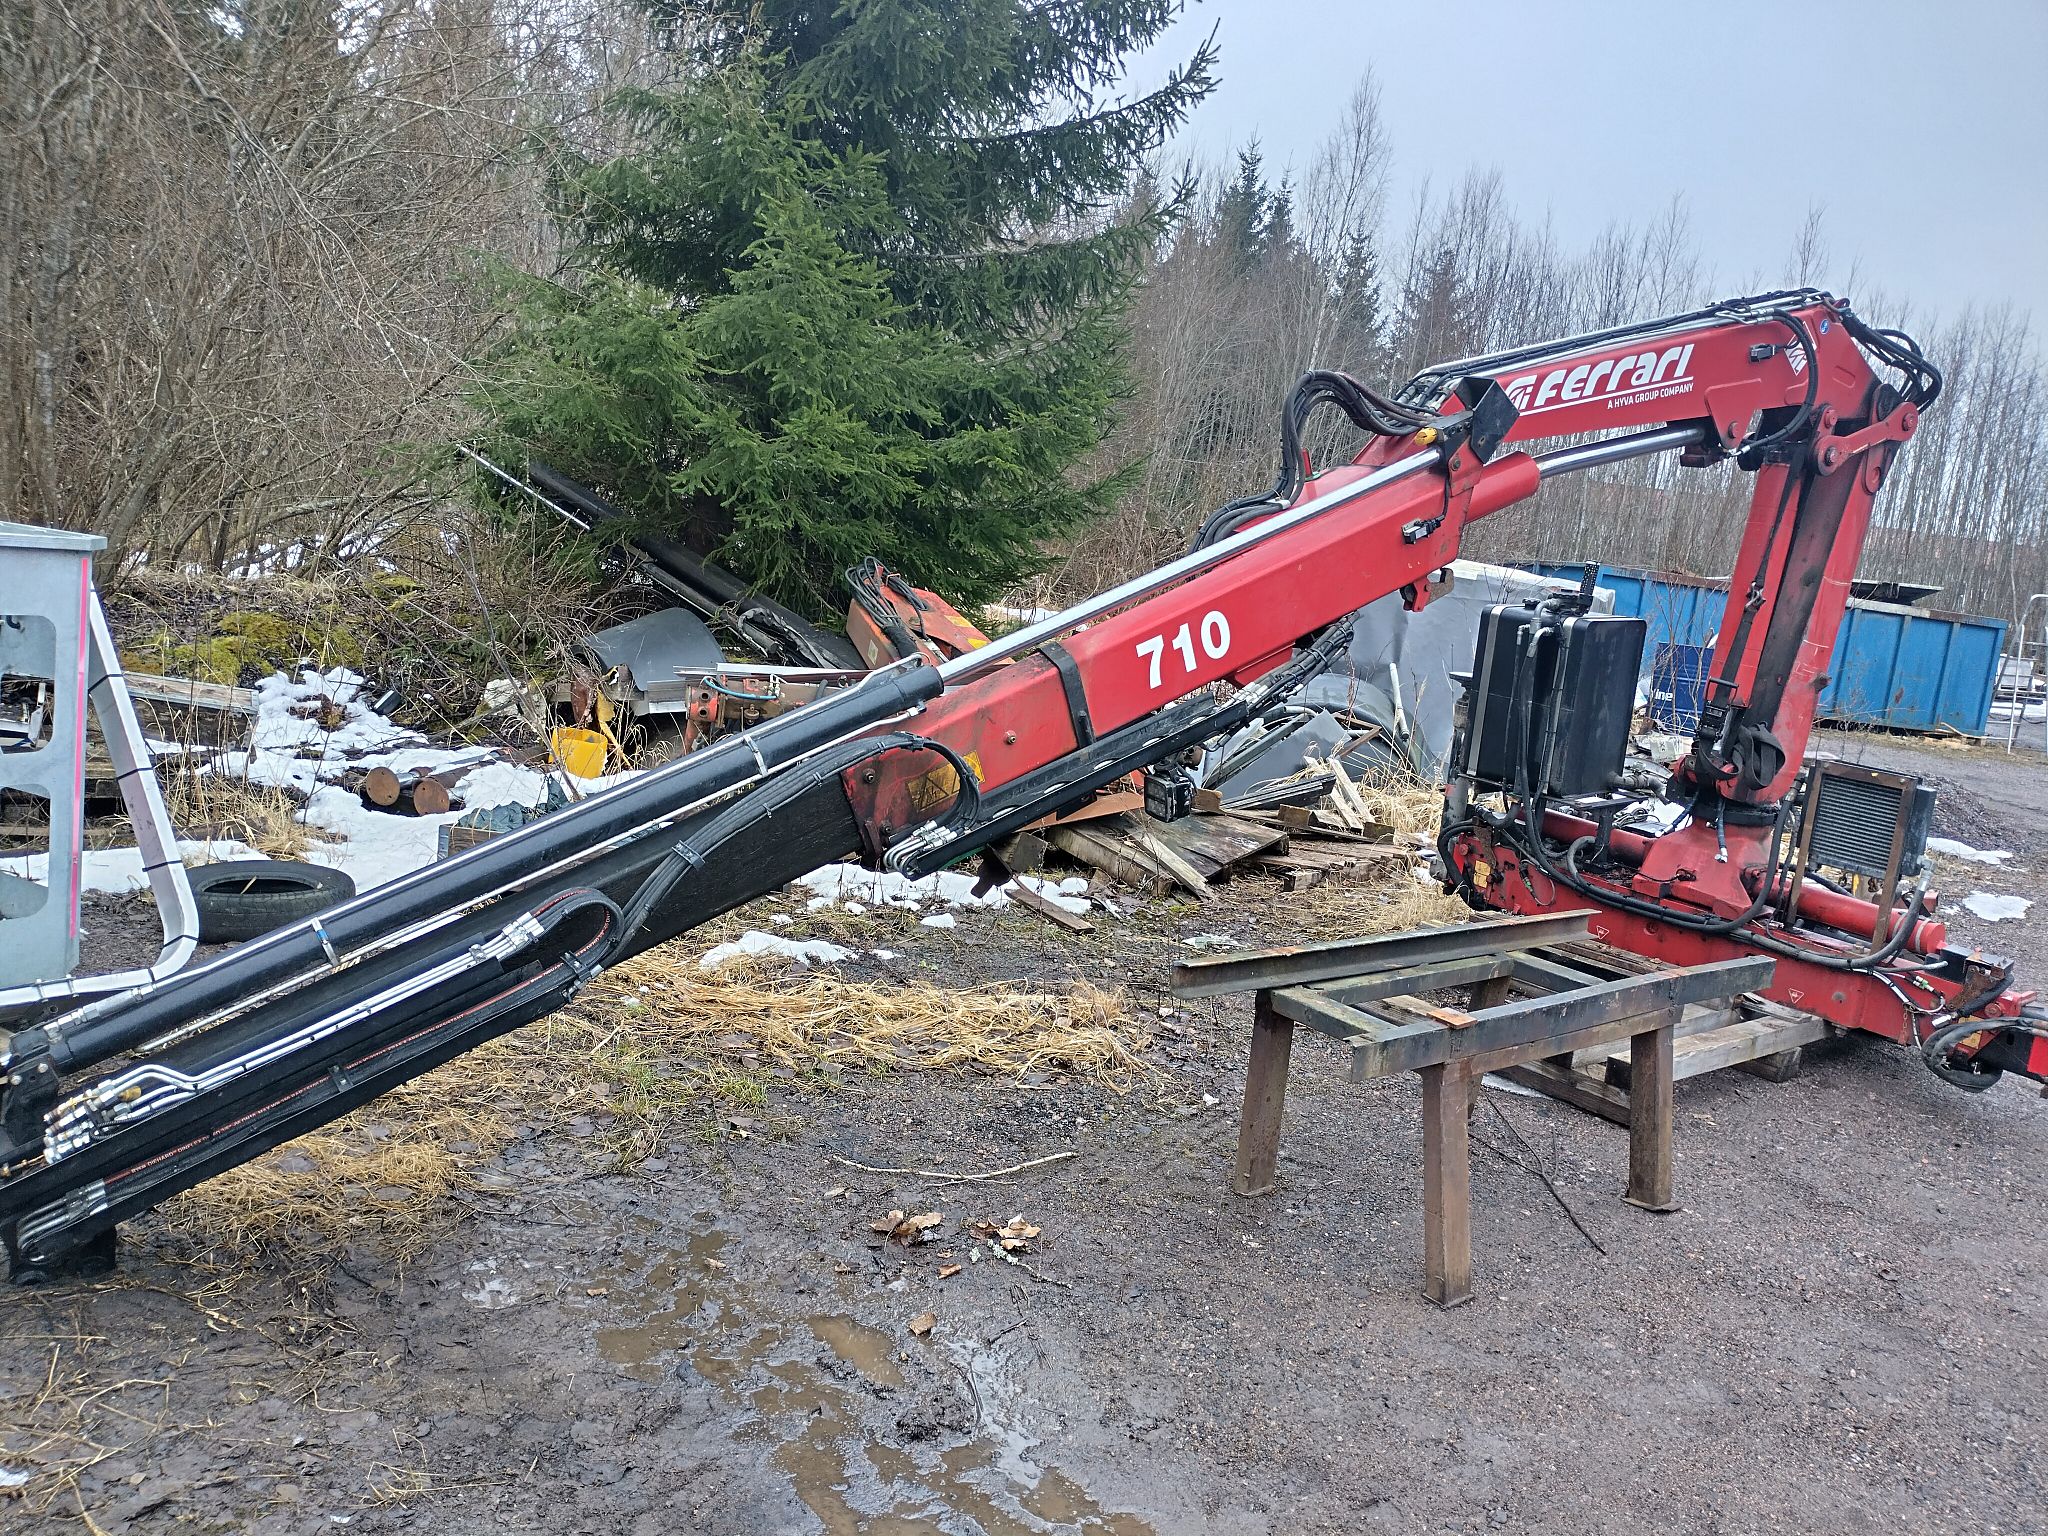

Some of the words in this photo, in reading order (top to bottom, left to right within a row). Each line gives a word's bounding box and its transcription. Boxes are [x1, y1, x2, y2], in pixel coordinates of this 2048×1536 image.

[1607, 399, 1613, 410] A
[1614, 396, 1633, 408] HYVA
[1635, 391, 1659, 403] GROUP
[1660, 382, 1694, 398] COMPANY
[1135, 610, 1231, 690] 710
